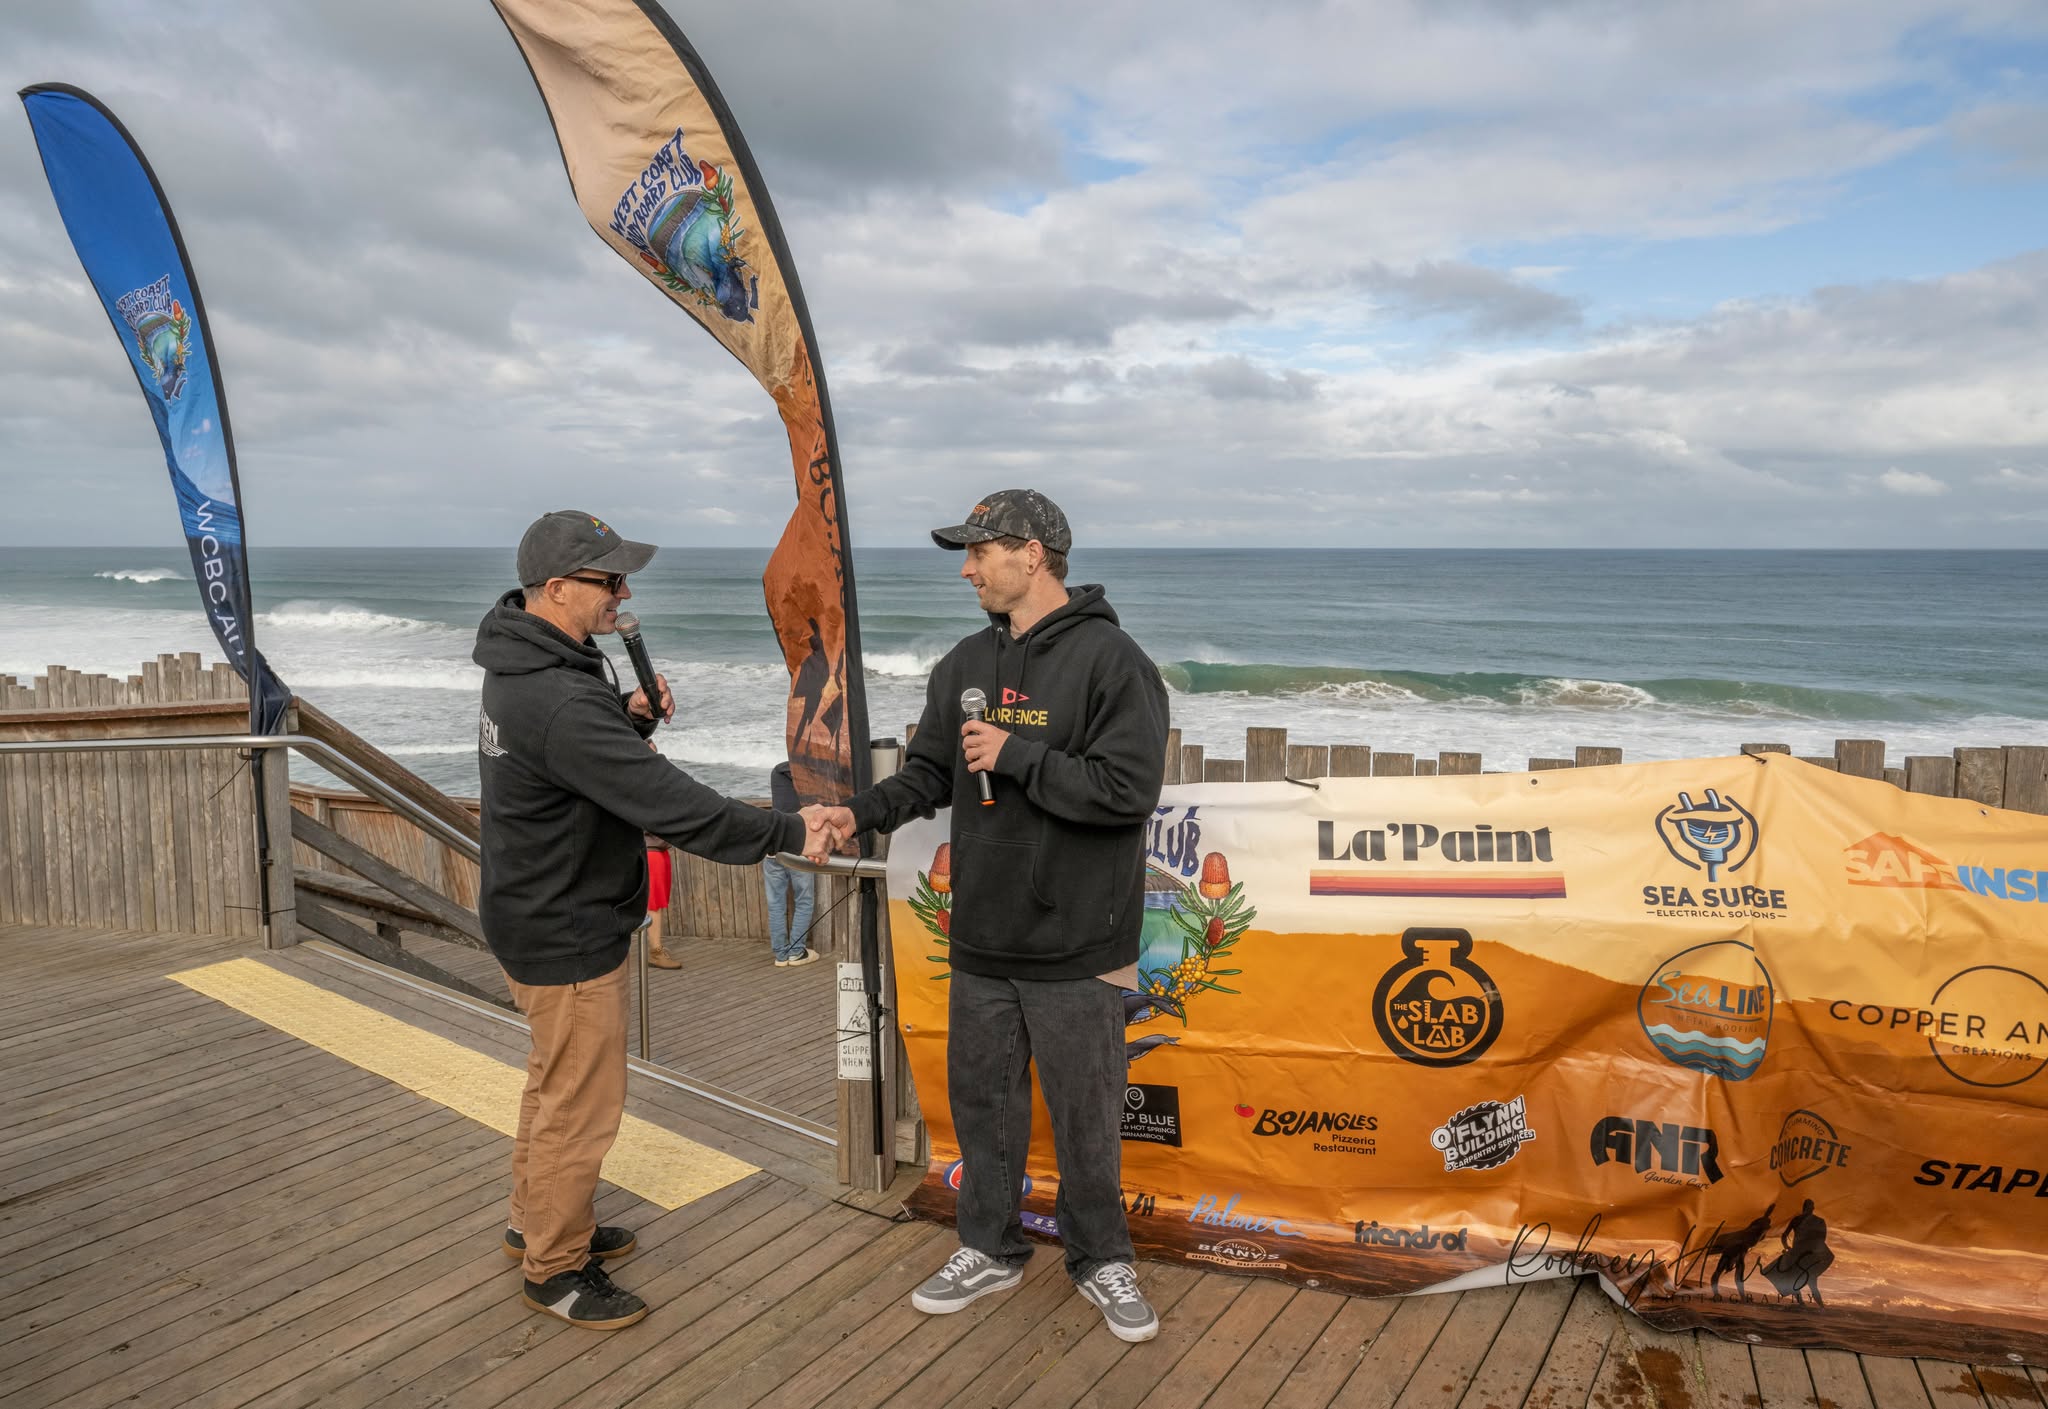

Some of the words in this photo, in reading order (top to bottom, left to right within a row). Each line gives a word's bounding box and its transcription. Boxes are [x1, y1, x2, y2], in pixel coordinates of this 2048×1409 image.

[609, 182, 638, 236] WEST
[641, 127, 685, 189] COAST
[669, 153, 703, 191] CLUB
[134, 275, 170, 300] COAST
[152, 293, 172, 314] CLUB
[984, 707, 1048, 726] LORENCE
[1318, 820, 1554, 863] La'Paint
[1643, 885, 1698, 907] SEA
[1702, 885, 1788, 909] SURGE
[1657, 909, 1725, 918] ELECTRICAL
[840, 978, 864, 991] CAUT
[1393, 1003, 1408, 1011] THE
[1408, 1000, 1479, 1025] SLAB
[1829, 1000, 1986, 1039] COPPER
[1414, 1024, 1466, 1048] LAB
[843, 1045, 870, 1055] SLIPPE
[1952, 1045, 2032, 1062] CREATIONS
[1121, 1112, 1135, 1123] EP
[1139, 1113, 1176, 1127] BLUE
[1147, 1126, 1176, 1134] SPRINGS
[1432, 1096, 1524, 1150] O'FLYNN
[1120, 1131, 1166, 1141] ARRNAMBOOL
[1332, 1134, 1375, 1146] Pizzeria
[1445, 1114, 1525, 1161] BUILDING
[1313, 1143, 1376, 1155] Restaurant
[1454, 1145, 1497, 1169] CARPENTRY
[1498, 1130, 1534, 1149] SERVICES
[1770, 1136, 1852, 1170] CONCRETE
[1644, 1172, 1682, 1186] Garden
